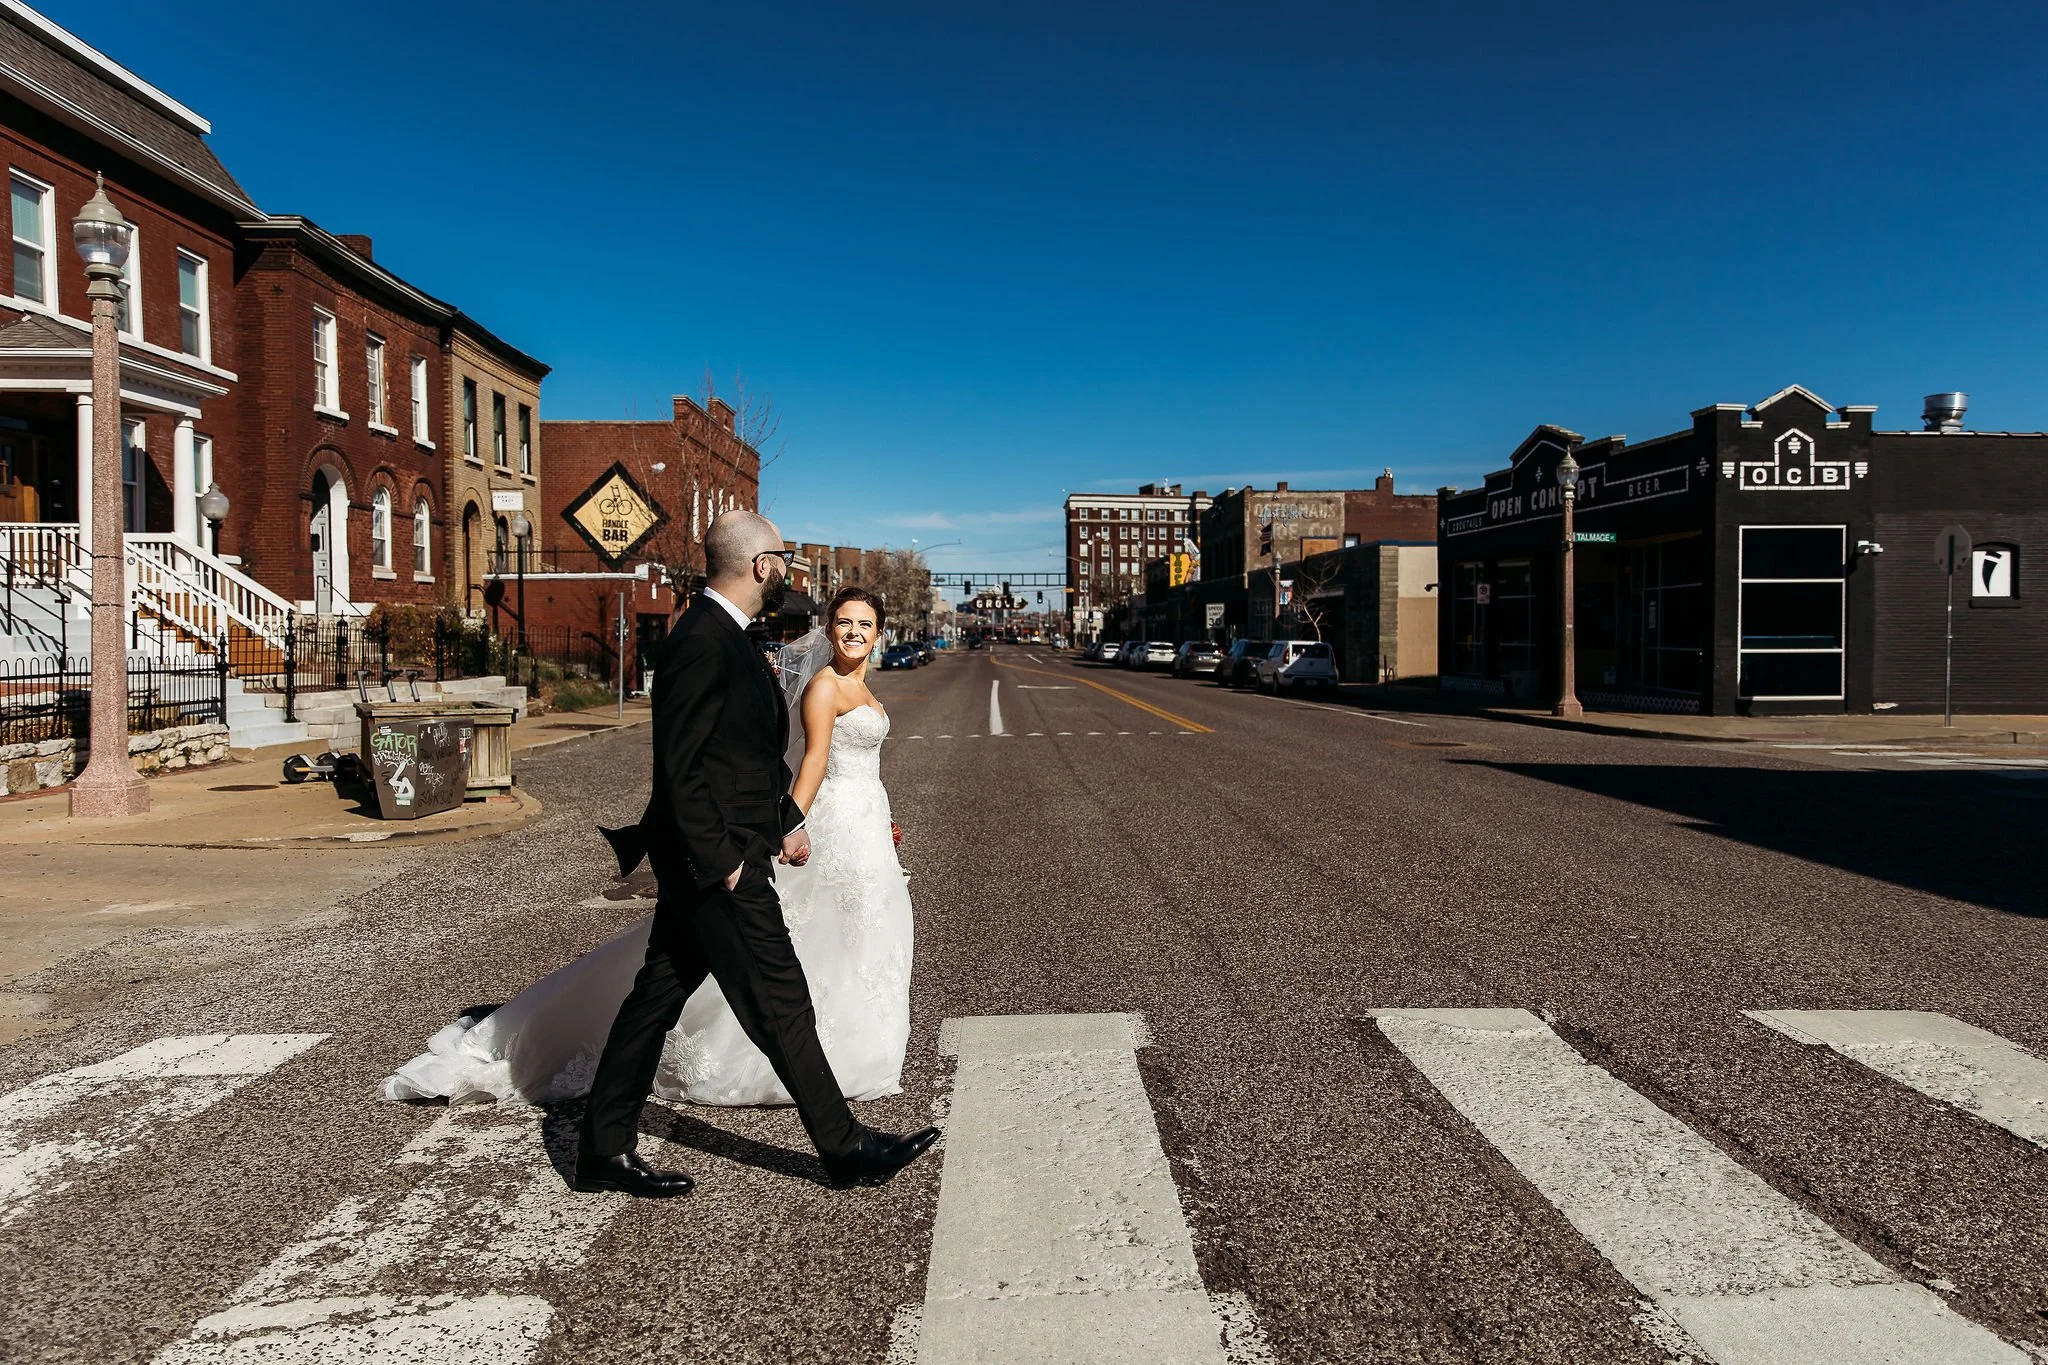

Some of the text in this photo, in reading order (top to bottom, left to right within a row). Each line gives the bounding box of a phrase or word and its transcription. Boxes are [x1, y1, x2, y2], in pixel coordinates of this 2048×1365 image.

[1629, 478, 1660, 497] BEER
[1492, 477, 1597, 519] OPEN CONCPT
[602, 519, 628, 528] HANDLE
[603, 529, 628, 542] BAR
[1576, 532, 1610, 542] TALMAGE
[1208, 617, 1221, 626] 30
[370, 732, 418, 757] GATOR
